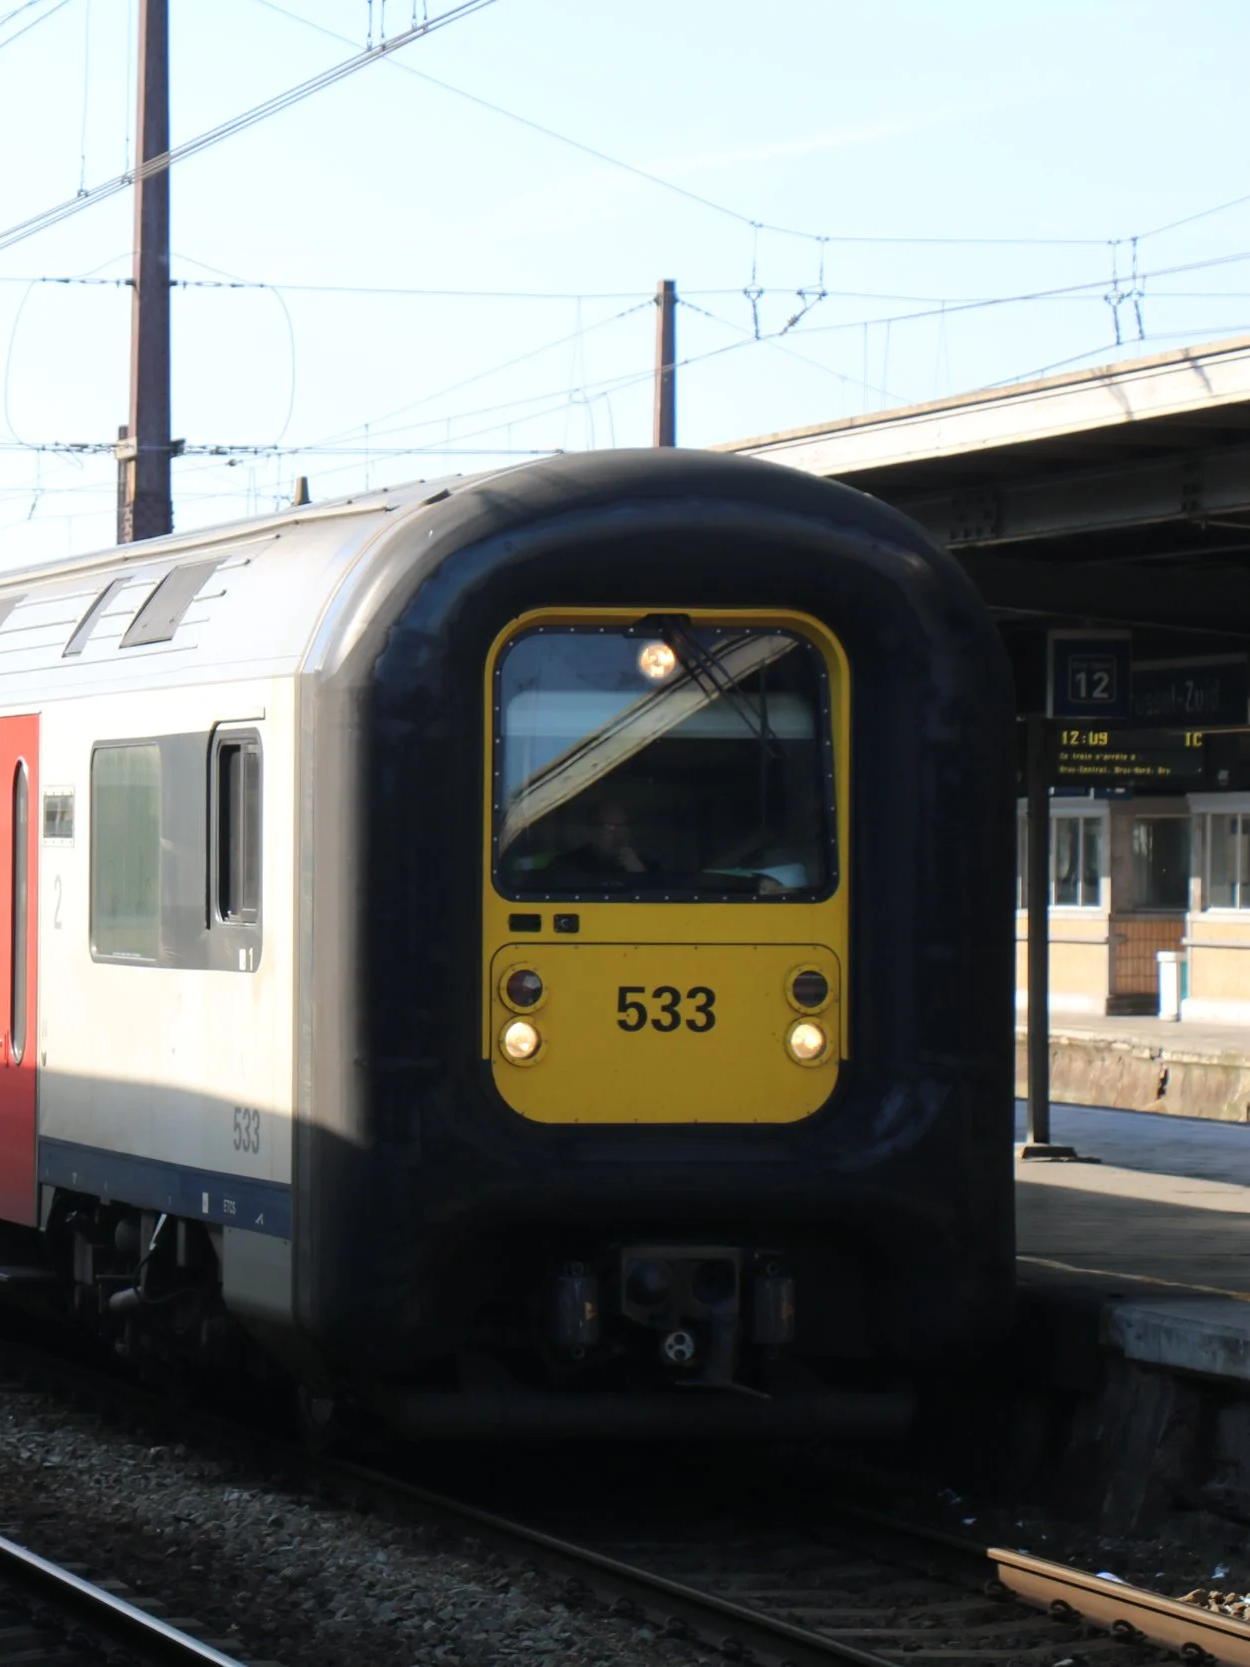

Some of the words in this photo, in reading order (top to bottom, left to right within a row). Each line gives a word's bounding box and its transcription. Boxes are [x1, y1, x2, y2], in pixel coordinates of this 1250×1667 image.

[1075, 671, 1110, 698] 12
[1184, 732, 1203, 747] IC
[54, 874, 62, 929] 2
[616, 986, 716, 1033] 533
[233, 1107, 260, 1154] 533
